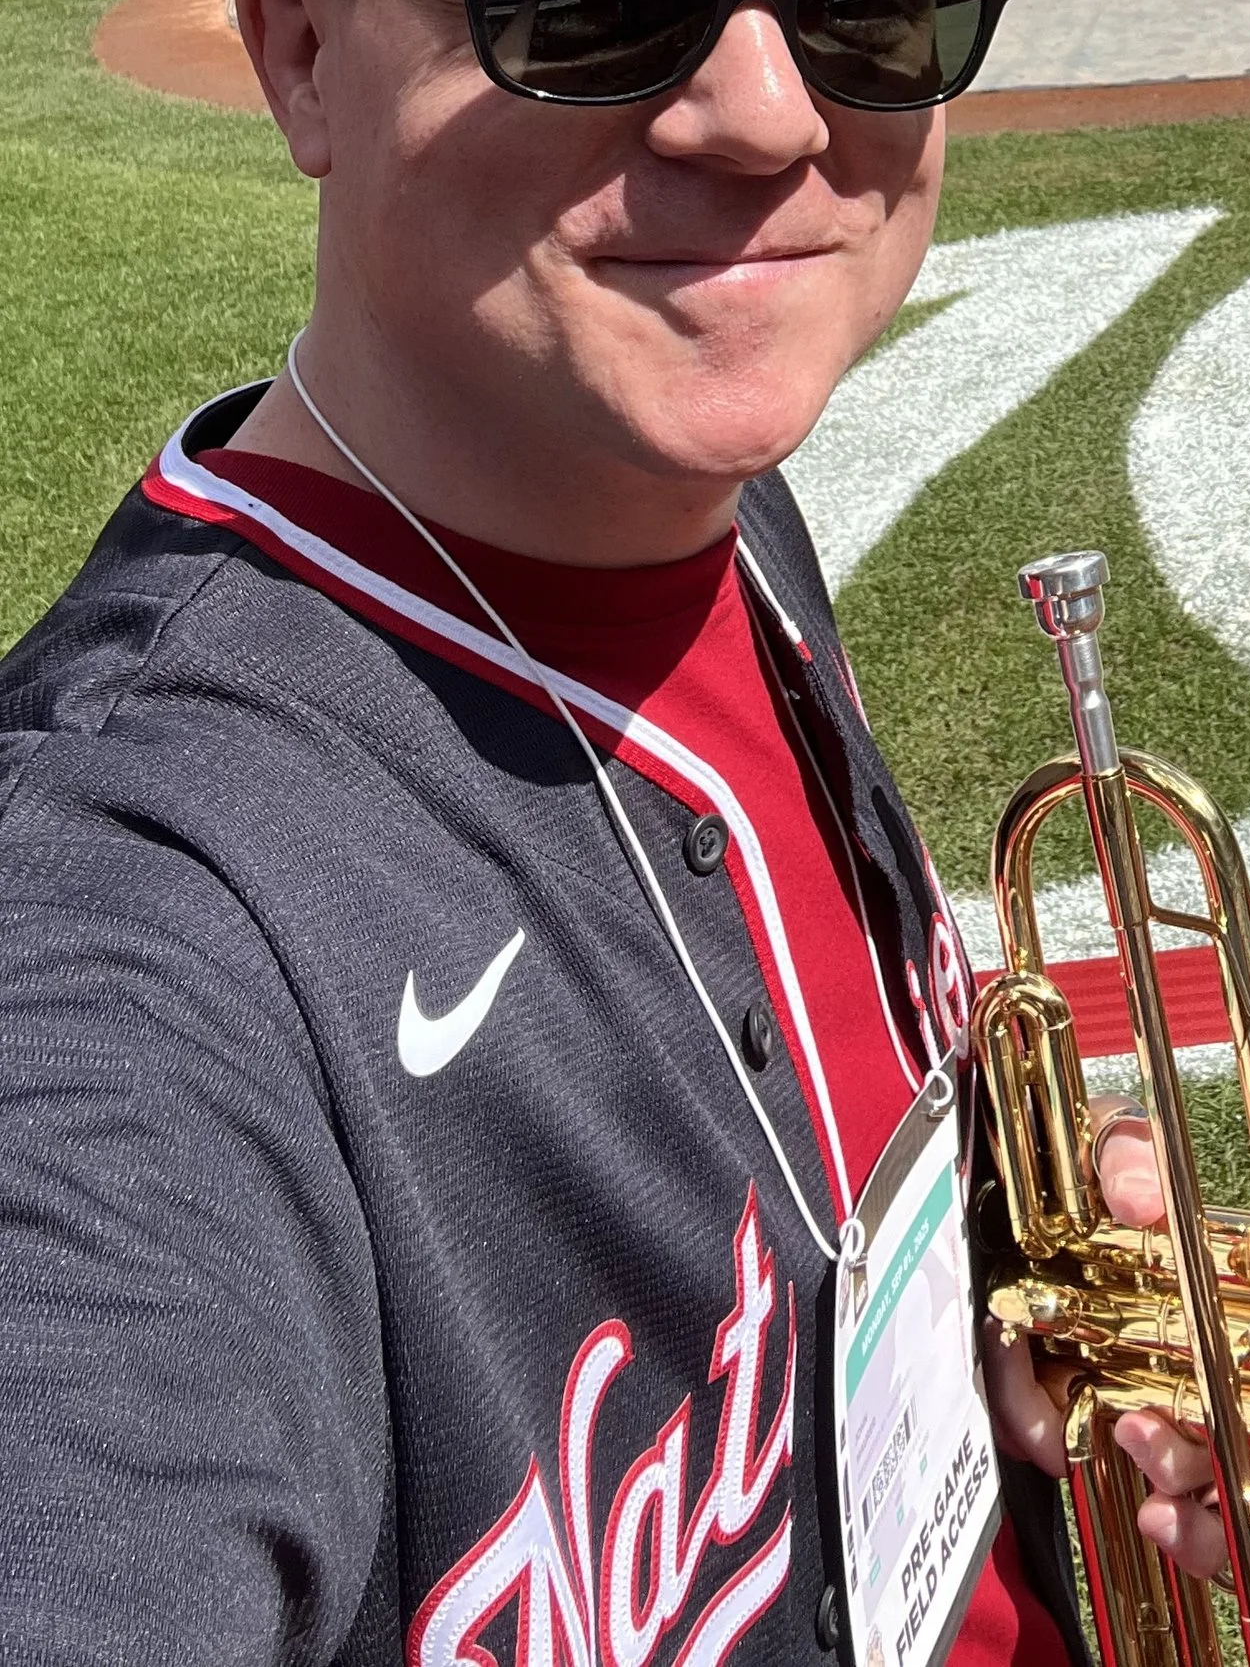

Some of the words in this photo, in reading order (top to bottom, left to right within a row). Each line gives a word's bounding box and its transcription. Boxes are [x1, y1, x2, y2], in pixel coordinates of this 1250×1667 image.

[861, 1289, 892, 1357] MONDAY,
[895, 1562, 938, 1667] FIELD
[941, 1442, 990, 1577] ACCESS
[901, 1426, 974, 1604] PRE-GAME
